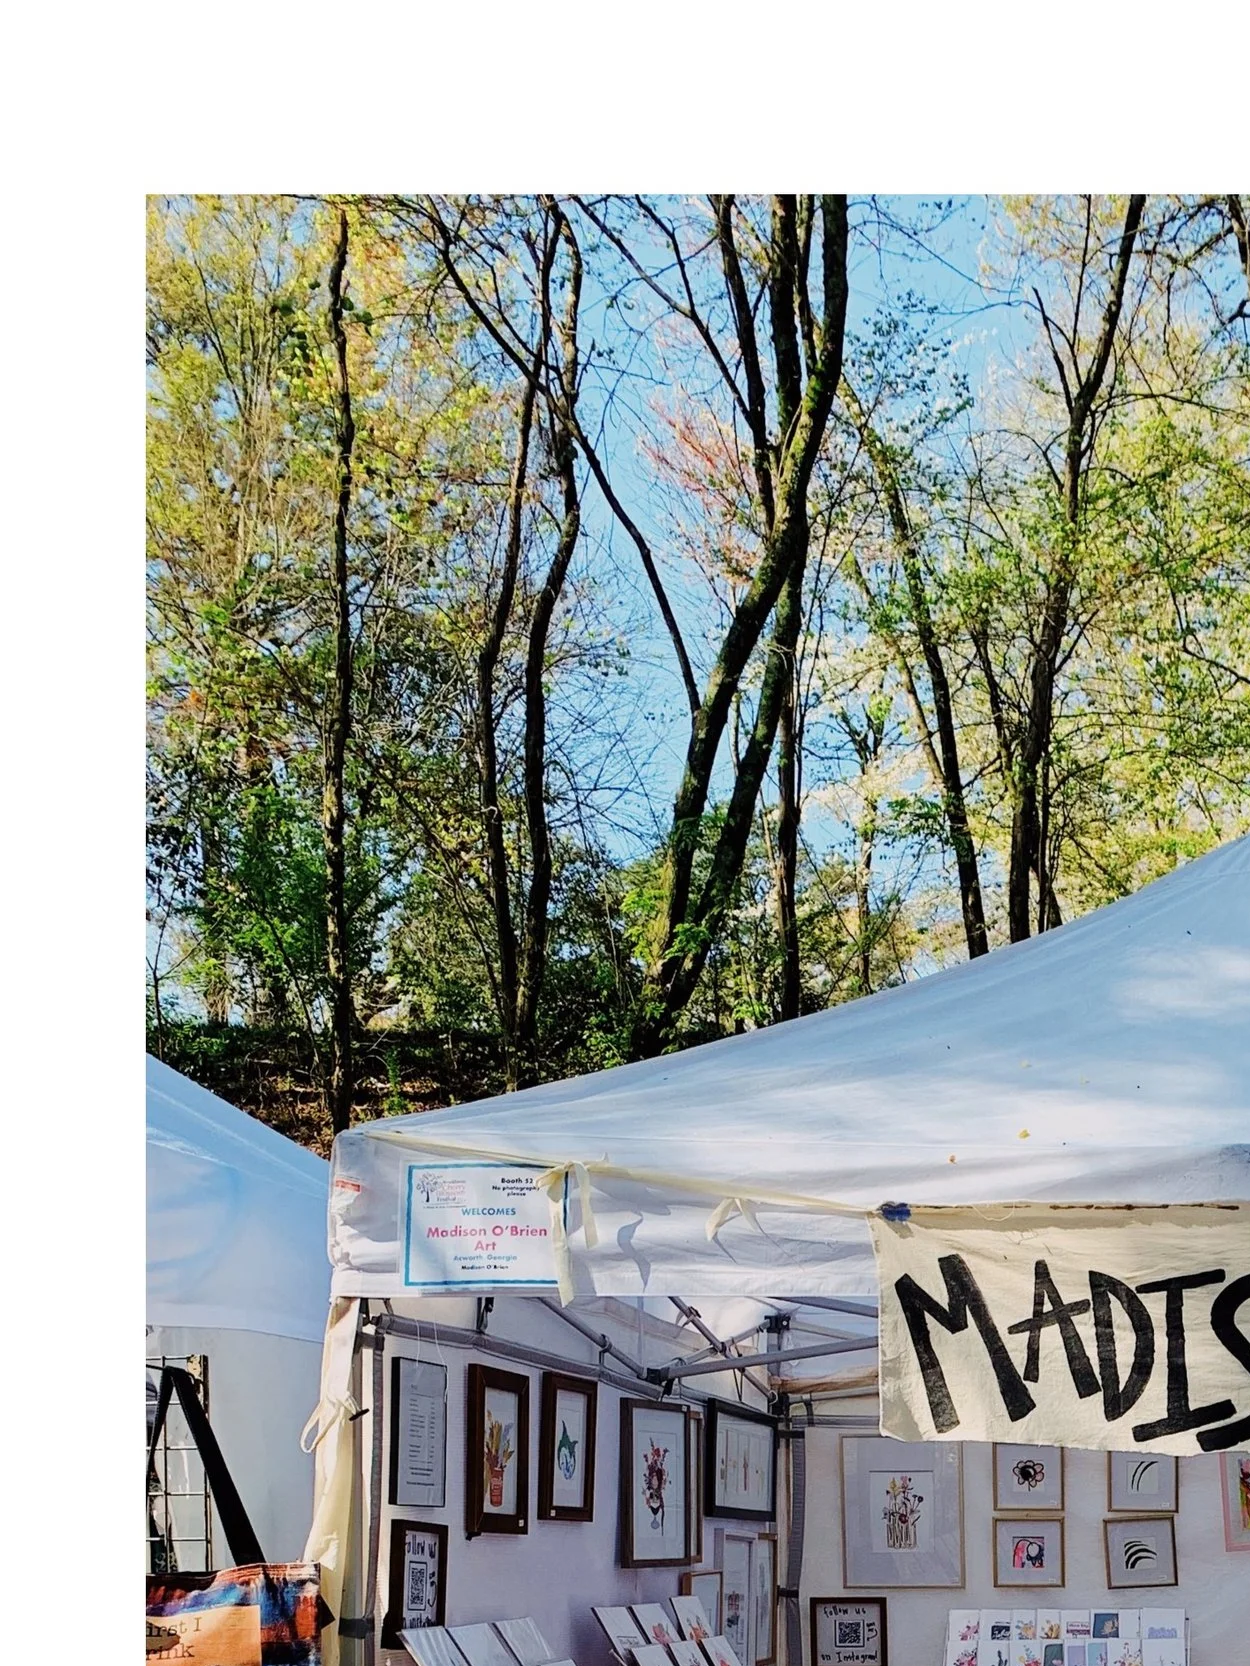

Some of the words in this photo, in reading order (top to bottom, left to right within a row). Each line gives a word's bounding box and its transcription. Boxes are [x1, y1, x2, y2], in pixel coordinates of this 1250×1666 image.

[461, 1207, 516, 1216] WELCOMES
[427, 1226, 487, 1238] Madison
[492, 1225, 547, 1237] O'Brien
[474, 1240, 496, 1251] Art
[194, 1617, 202, 1632] I
